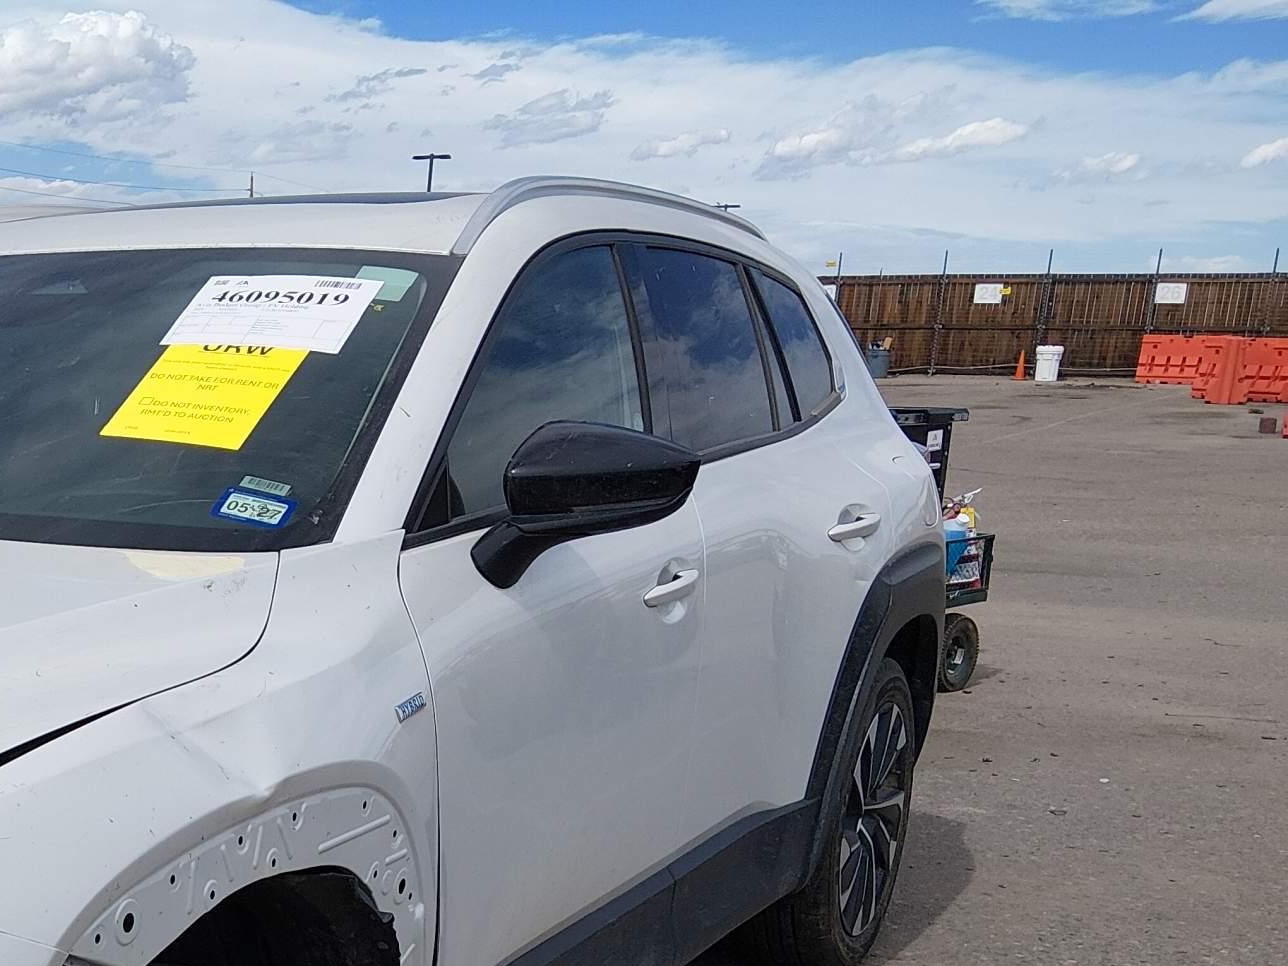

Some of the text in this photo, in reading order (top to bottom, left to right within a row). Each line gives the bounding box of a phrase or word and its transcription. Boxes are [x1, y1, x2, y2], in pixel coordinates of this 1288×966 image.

[212, 290, 350, 305] 46095019
[189, 375, 213, 383] TAKE
[213, 377, 233, 385] FOR
[235, 379, 263, 387] RENT
[187, 413, 235, 423] AUCTION
[226, 500, 251, 513] 05
